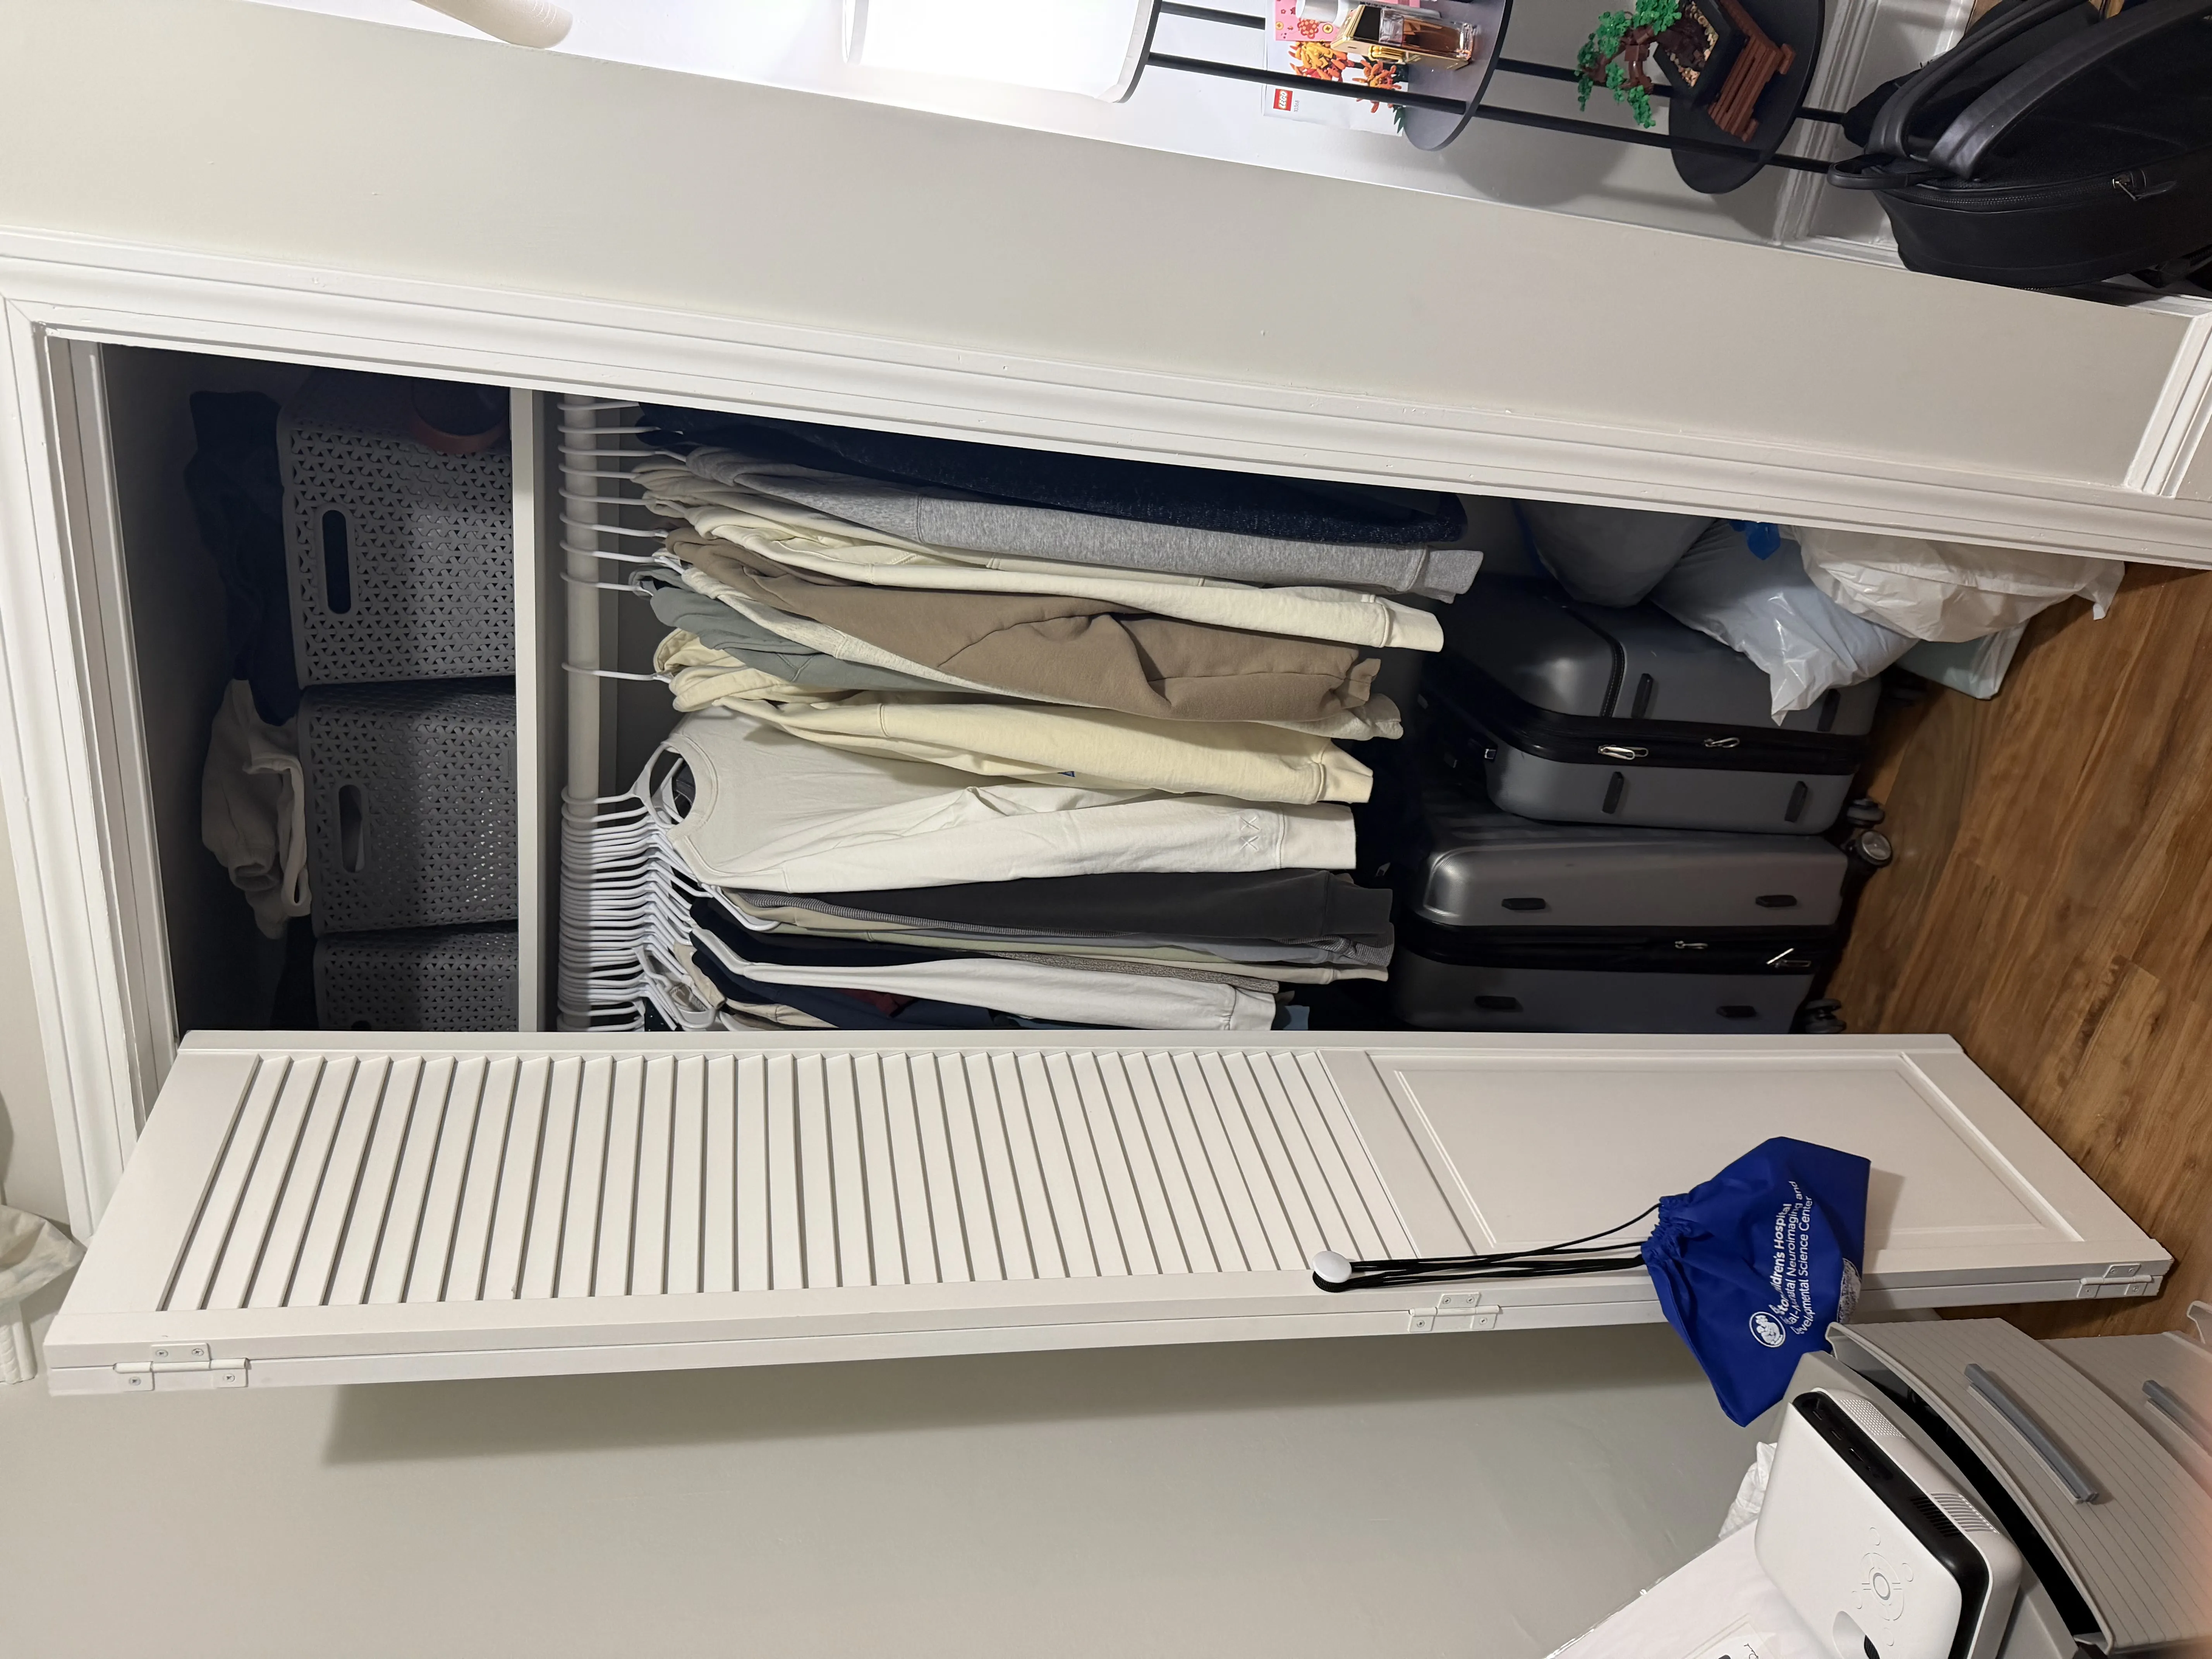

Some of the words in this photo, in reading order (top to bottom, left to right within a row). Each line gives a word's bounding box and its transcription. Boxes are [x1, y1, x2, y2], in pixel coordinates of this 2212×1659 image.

[1279, 90, 1288, 109] LEGO
[1788, 1180, 1803, 1200] and
[1774, 1204, 1792, 1249] Hospital
[1798, 1196, 1813, 1231] Center
[1786, 1203, 1803, 1276] Neuroimaging
[1798, 1233, 1809, 1276] Science
